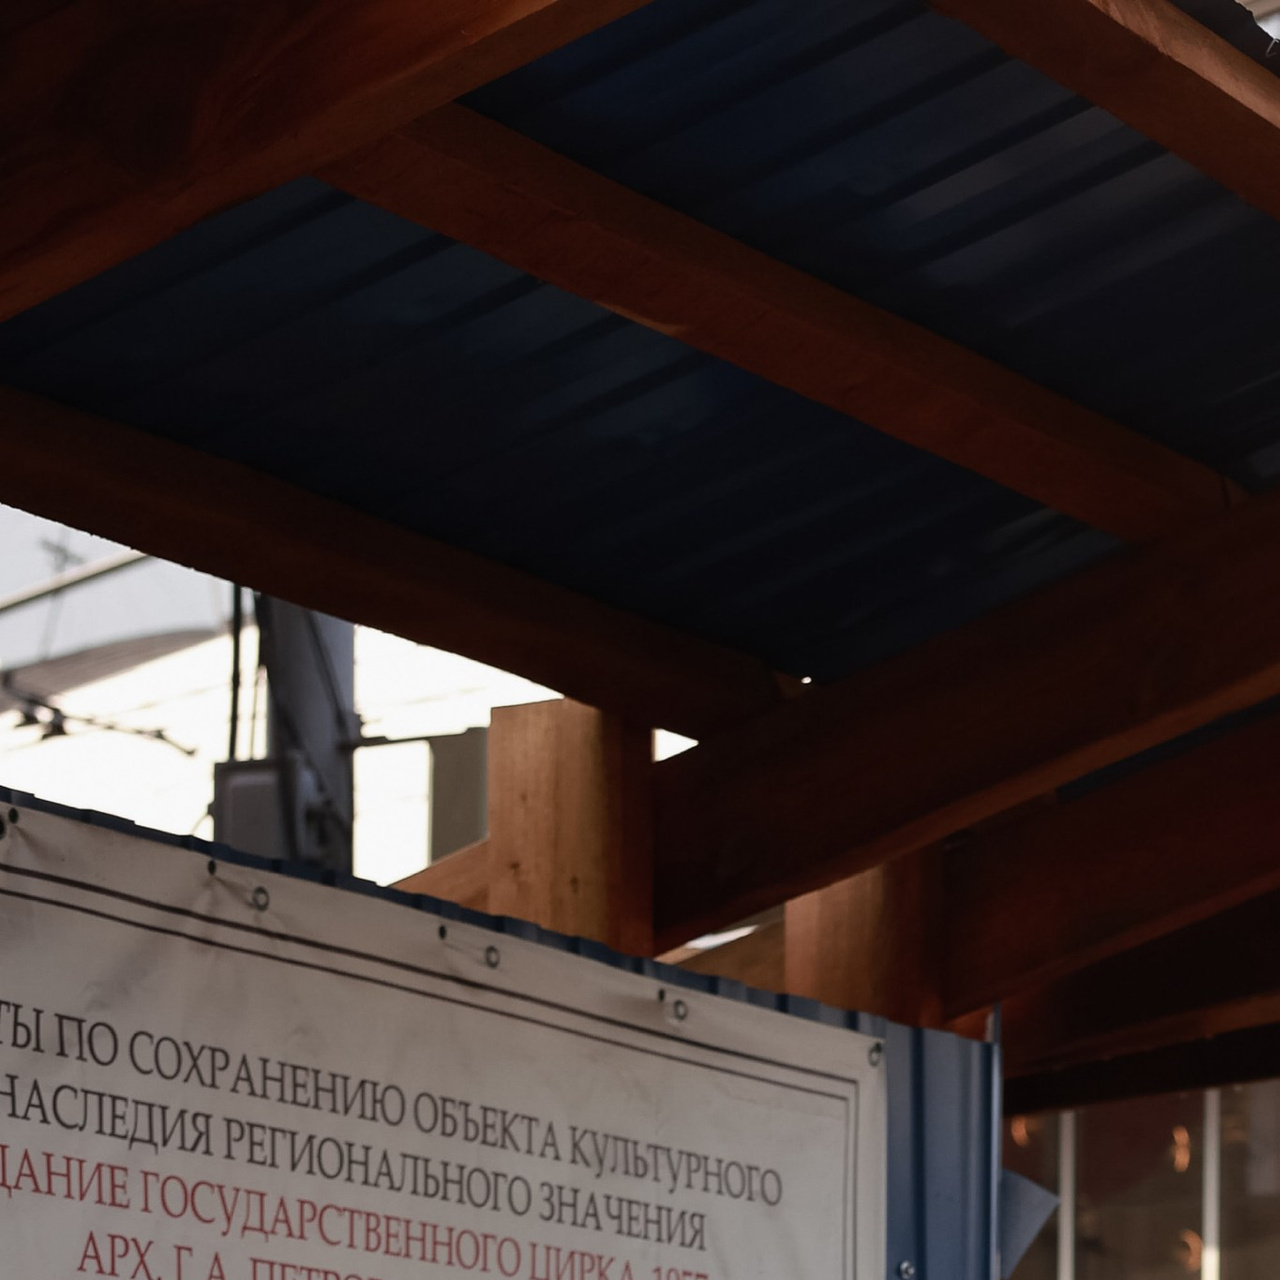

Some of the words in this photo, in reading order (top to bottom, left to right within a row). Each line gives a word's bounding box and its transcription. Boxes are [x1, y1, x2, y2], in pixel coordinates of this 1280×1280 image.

[54, 1012, 119, 1067] ПО
[128, 1030, 406, 1127] СОХРАНЕНИЮ
[413, 1091, 562, 1162] ОБЪЕКТА
[568, 1125, 783, 1207] КУЛЬТУРНОГО
[140, 1169, 522, 1279] ГОСУДАРСТВЕННОГО
[223, 1117, 532, 1216] РЕГИОНАЛЬНОГО
[538, 1181, 707, 1251] ЗНАЧЕНИЯ
